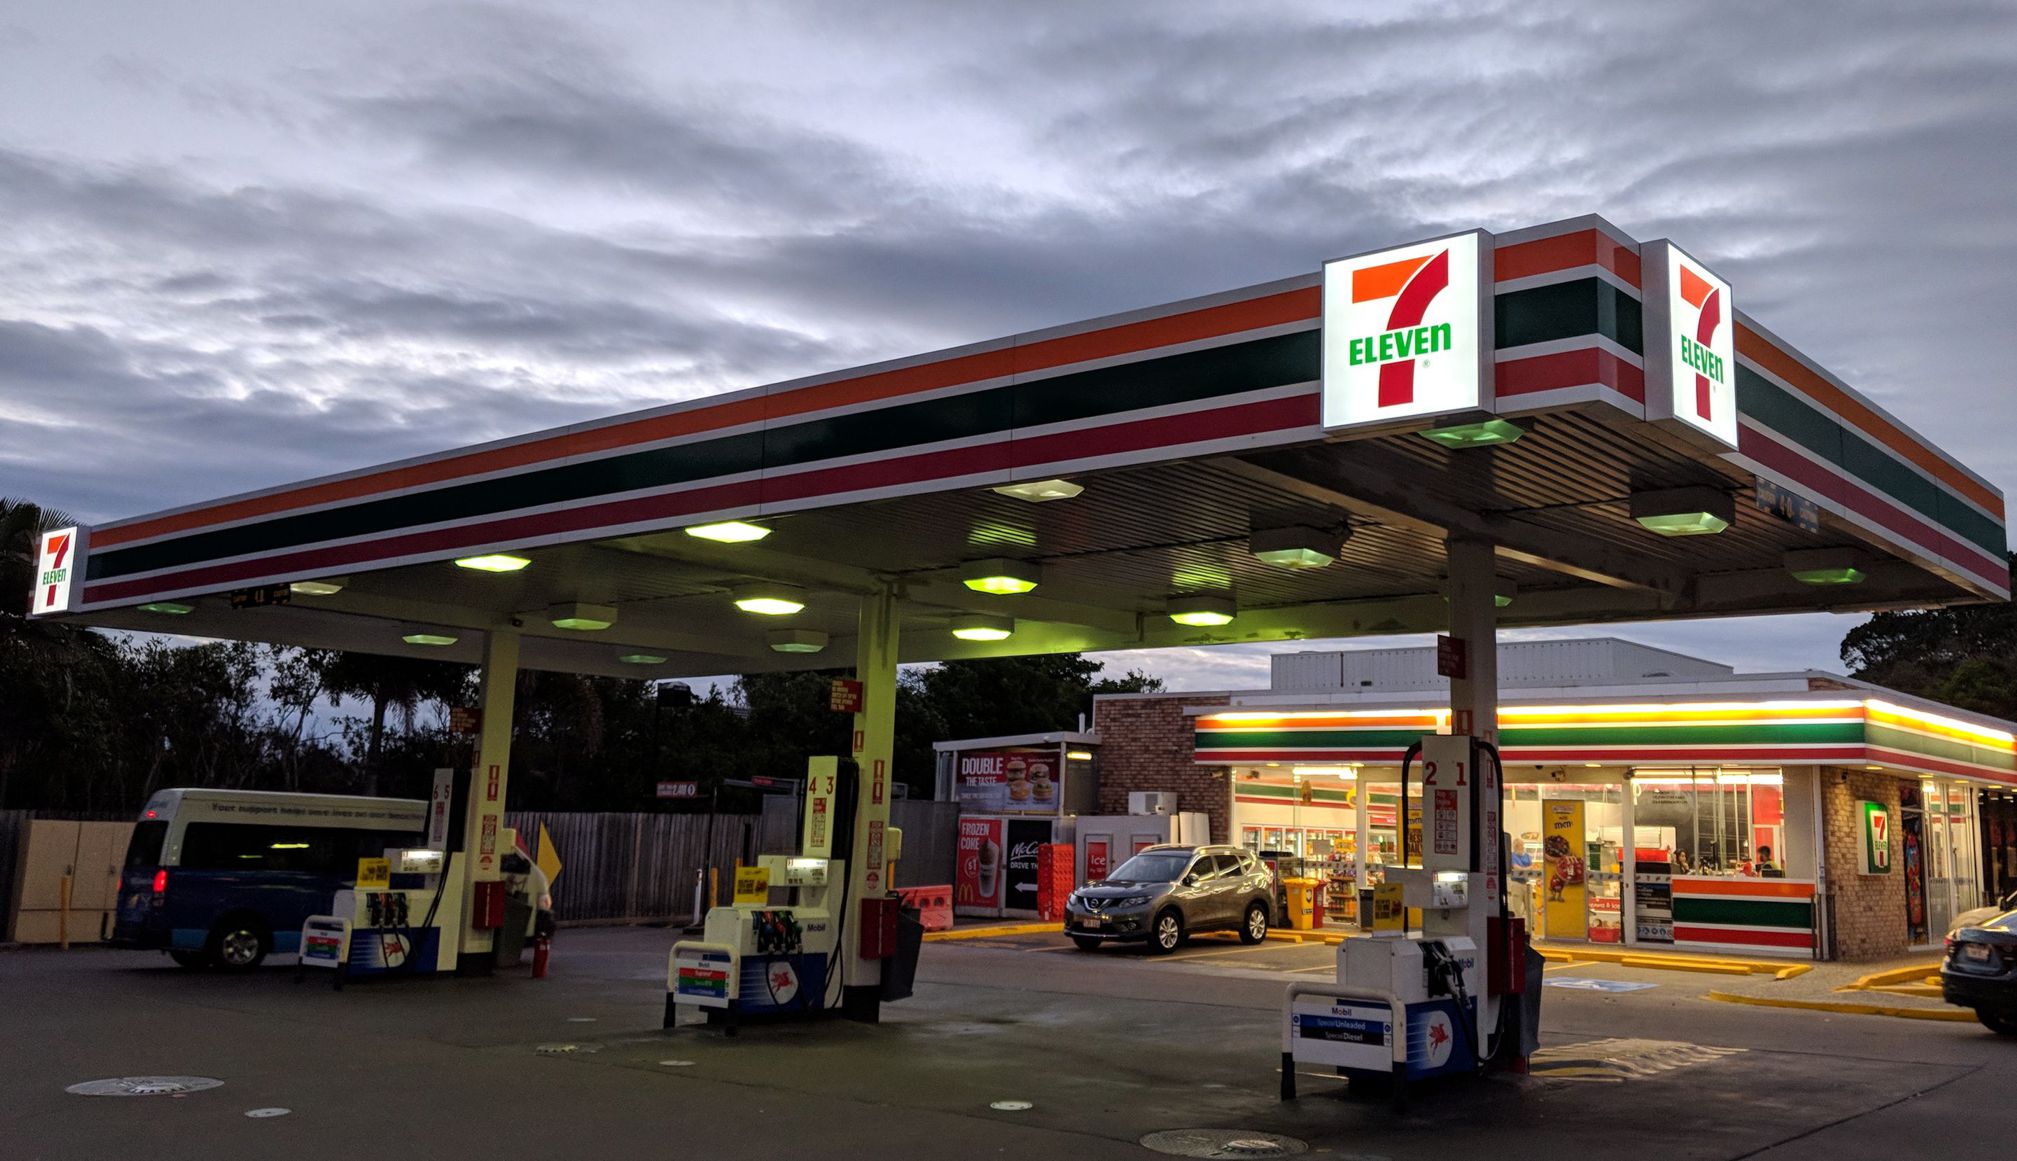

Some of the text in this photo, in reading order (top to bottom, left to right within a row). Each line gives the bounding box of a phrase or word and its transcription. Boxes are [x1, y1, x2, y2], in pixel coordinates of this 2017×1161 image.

[1352, 248, 1448, 408] 7
[1680, 263, 1720, 422] 7
[47, 532, 70, 607] 7
[961, 757, 1004, 775] DOUBLE
[1425, 762, 1467, 786] 2 1
[809, 776, 834, 795] 4 3
[961, 823, 990, 836] FROZEN
[1874, 816, 1885, 866] 7
[1010, 862, 1030, 870] DRIVE
[1091, 855, 1106, 865] Ice
[807, 923, 826, 932] Mobil
[1331, 1007, 1352, 1016] Mobil
